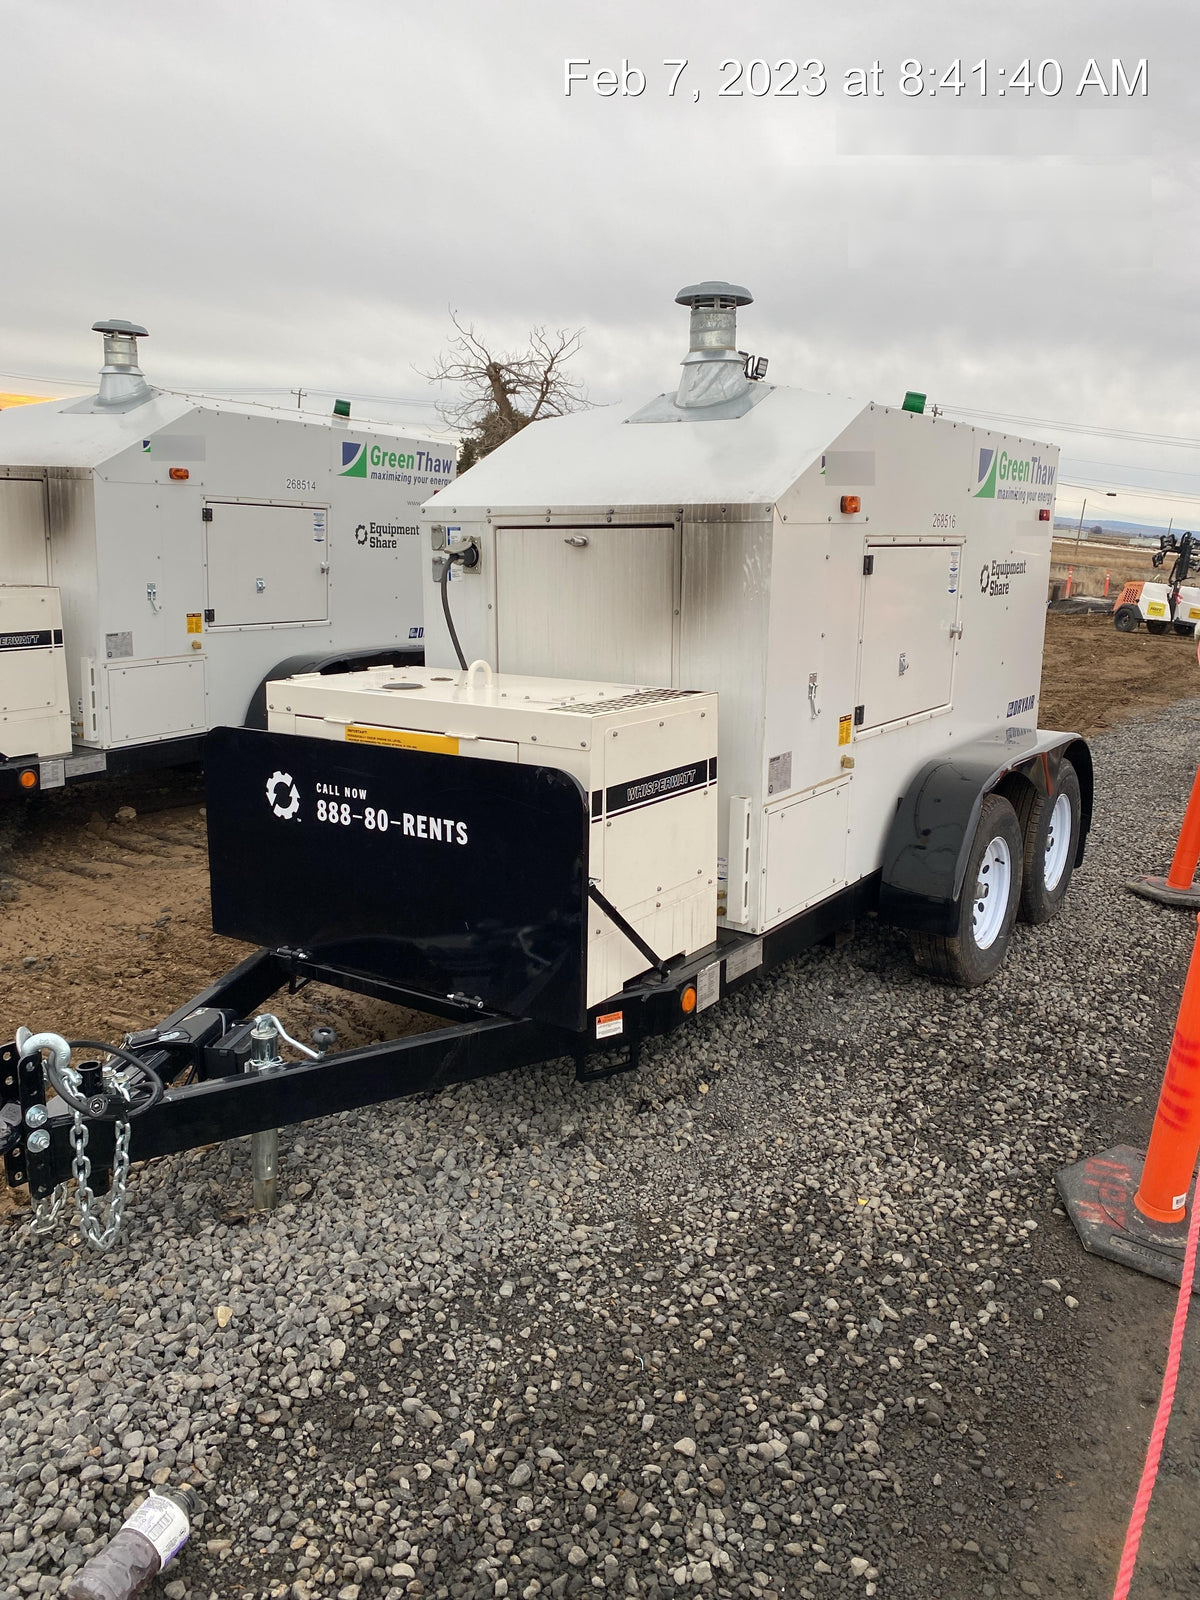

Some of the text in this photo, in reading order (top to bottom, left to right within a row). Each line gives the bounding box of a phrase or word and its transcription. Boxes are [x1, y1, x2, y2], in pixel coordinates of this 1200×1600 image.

[286, 479, 316, 490] 268514
[370, 471, 412, 485] maximizing
[413, 475, 428, 485] your
[997, 486, 1053, 505] maximizing your energy
[932, 513, 956, 528] 268516
[369, 522, 420, 537] Equipment
[369, 537, 397, 548] Share
[990, 559, 1027, 579] Equipment
[989, 580, 1010, 596] Share
[316, 782, 367, 800] CALL NOW
[627, 769, 697, 802] WHISPERWATT
[317, 799, 468, 845] 888-80-RENTS
